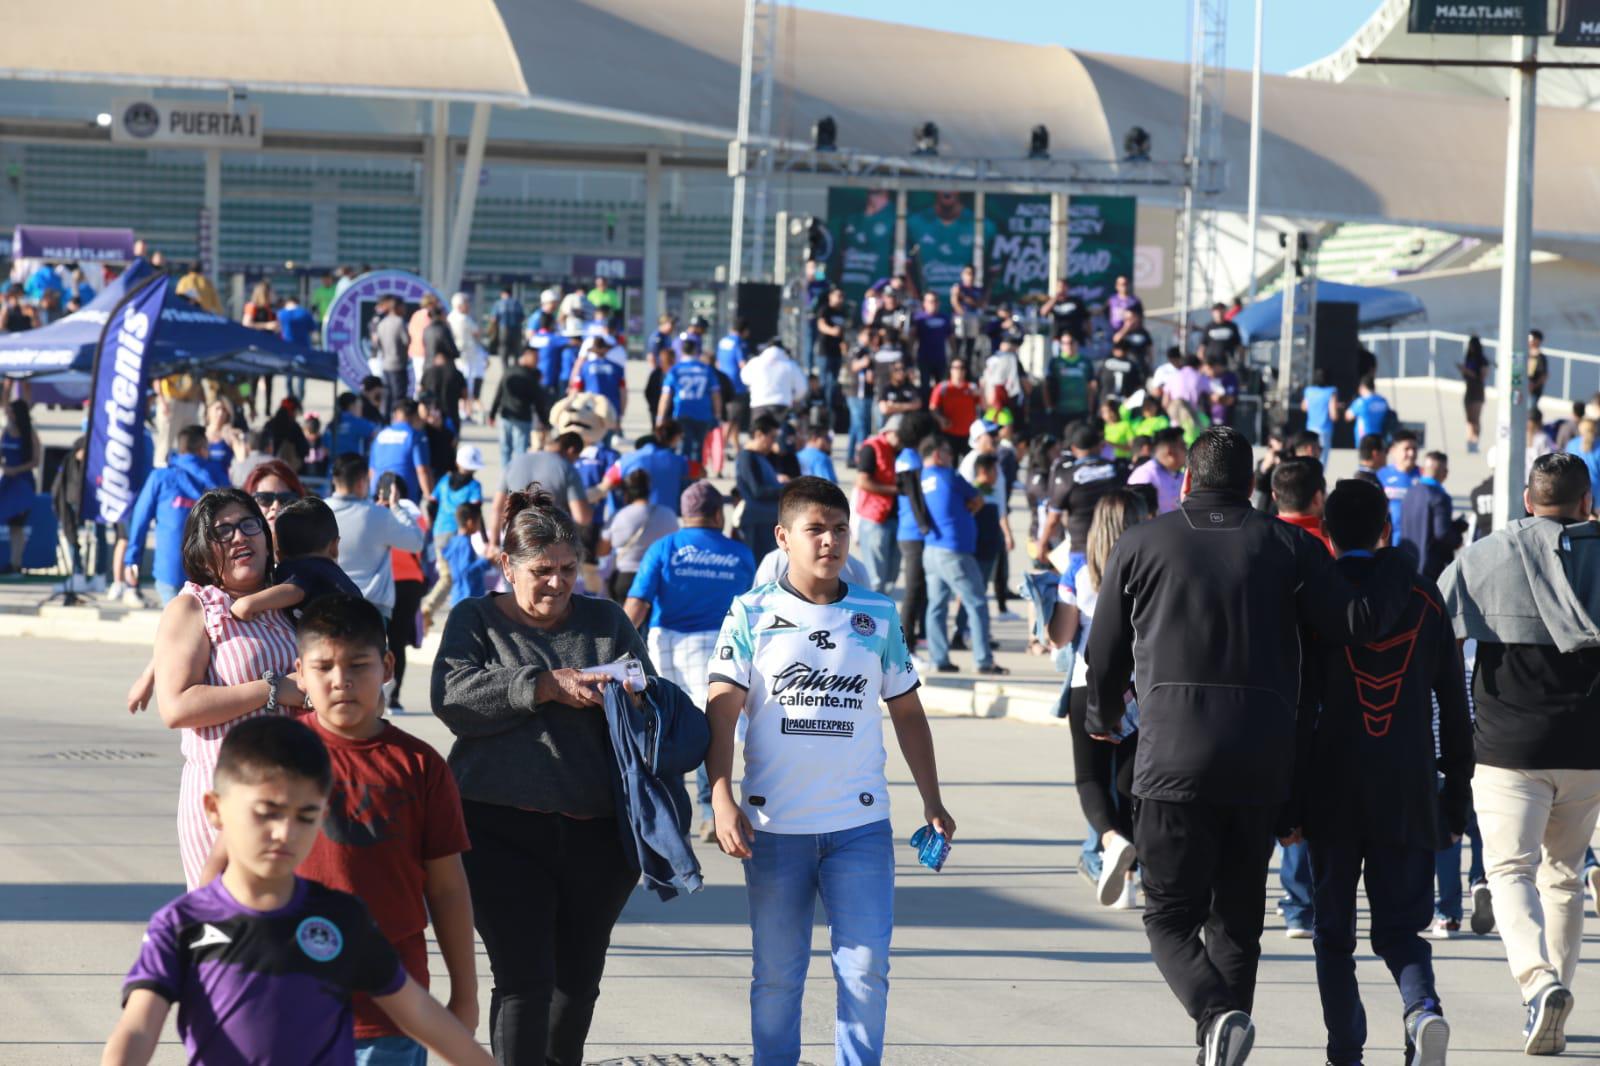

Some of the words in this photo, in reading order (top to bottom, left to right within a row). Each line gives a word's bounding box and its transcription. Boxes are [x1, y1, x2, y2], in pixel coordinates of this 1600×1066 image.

[170, 111, 244, 135] PUERTA
[678, 375, 708, 400] 27
[671, 545, 739, 567] Caliente
[674, 567, 735, 580] caliente.mx
[771, 661, 868, 697] Caliente
[779, 692, 864, 710] caliente.mx
[788, 718, 855, 732] PAQUETEXPRESS
